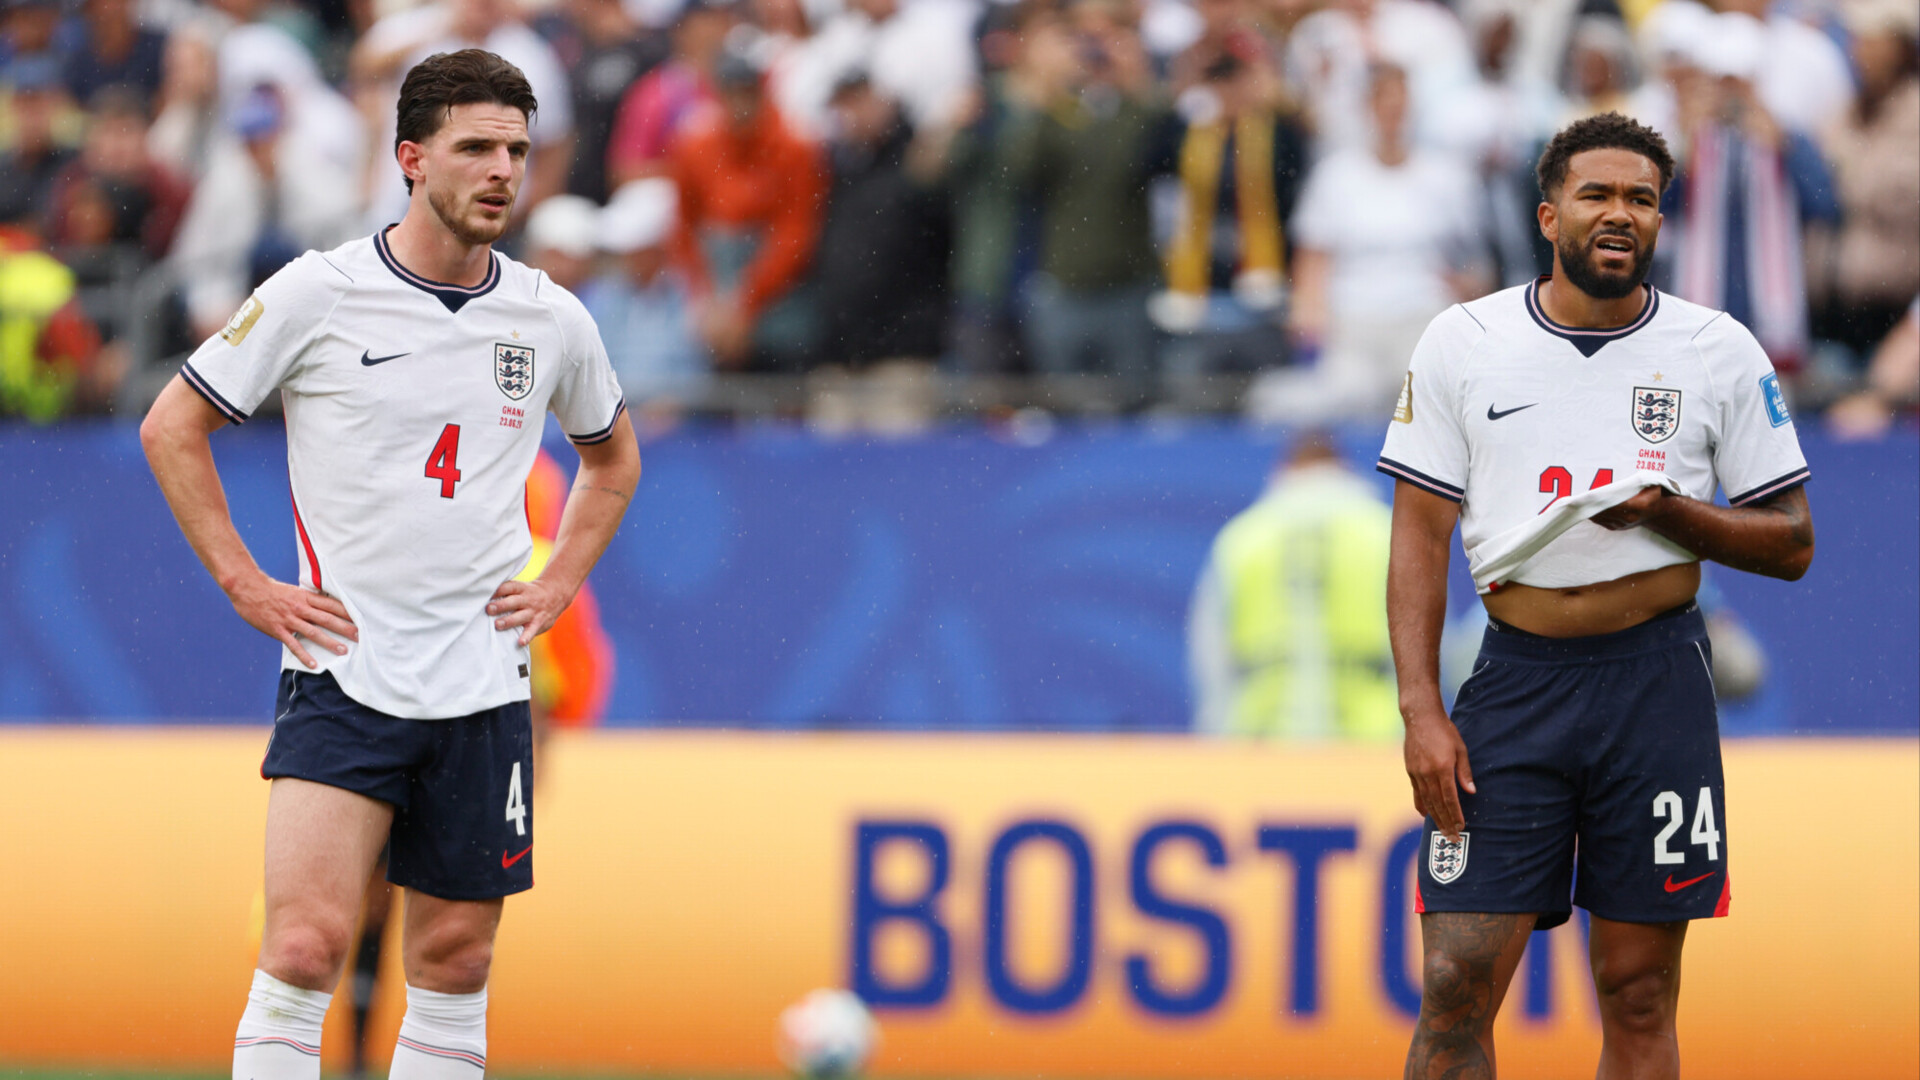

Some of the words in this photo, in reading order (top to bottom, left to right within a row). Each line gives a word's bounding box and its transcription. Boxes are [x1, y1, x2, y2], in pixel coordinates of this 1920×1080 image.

[424, 423, 462, 499] 4
[1636, 459, 1666, 472] 23.06.26
[1638, 448, 1666, 460] GHANA
[505, 761, 527, 836] 4
[1652, 786, 1721, 865] 24
